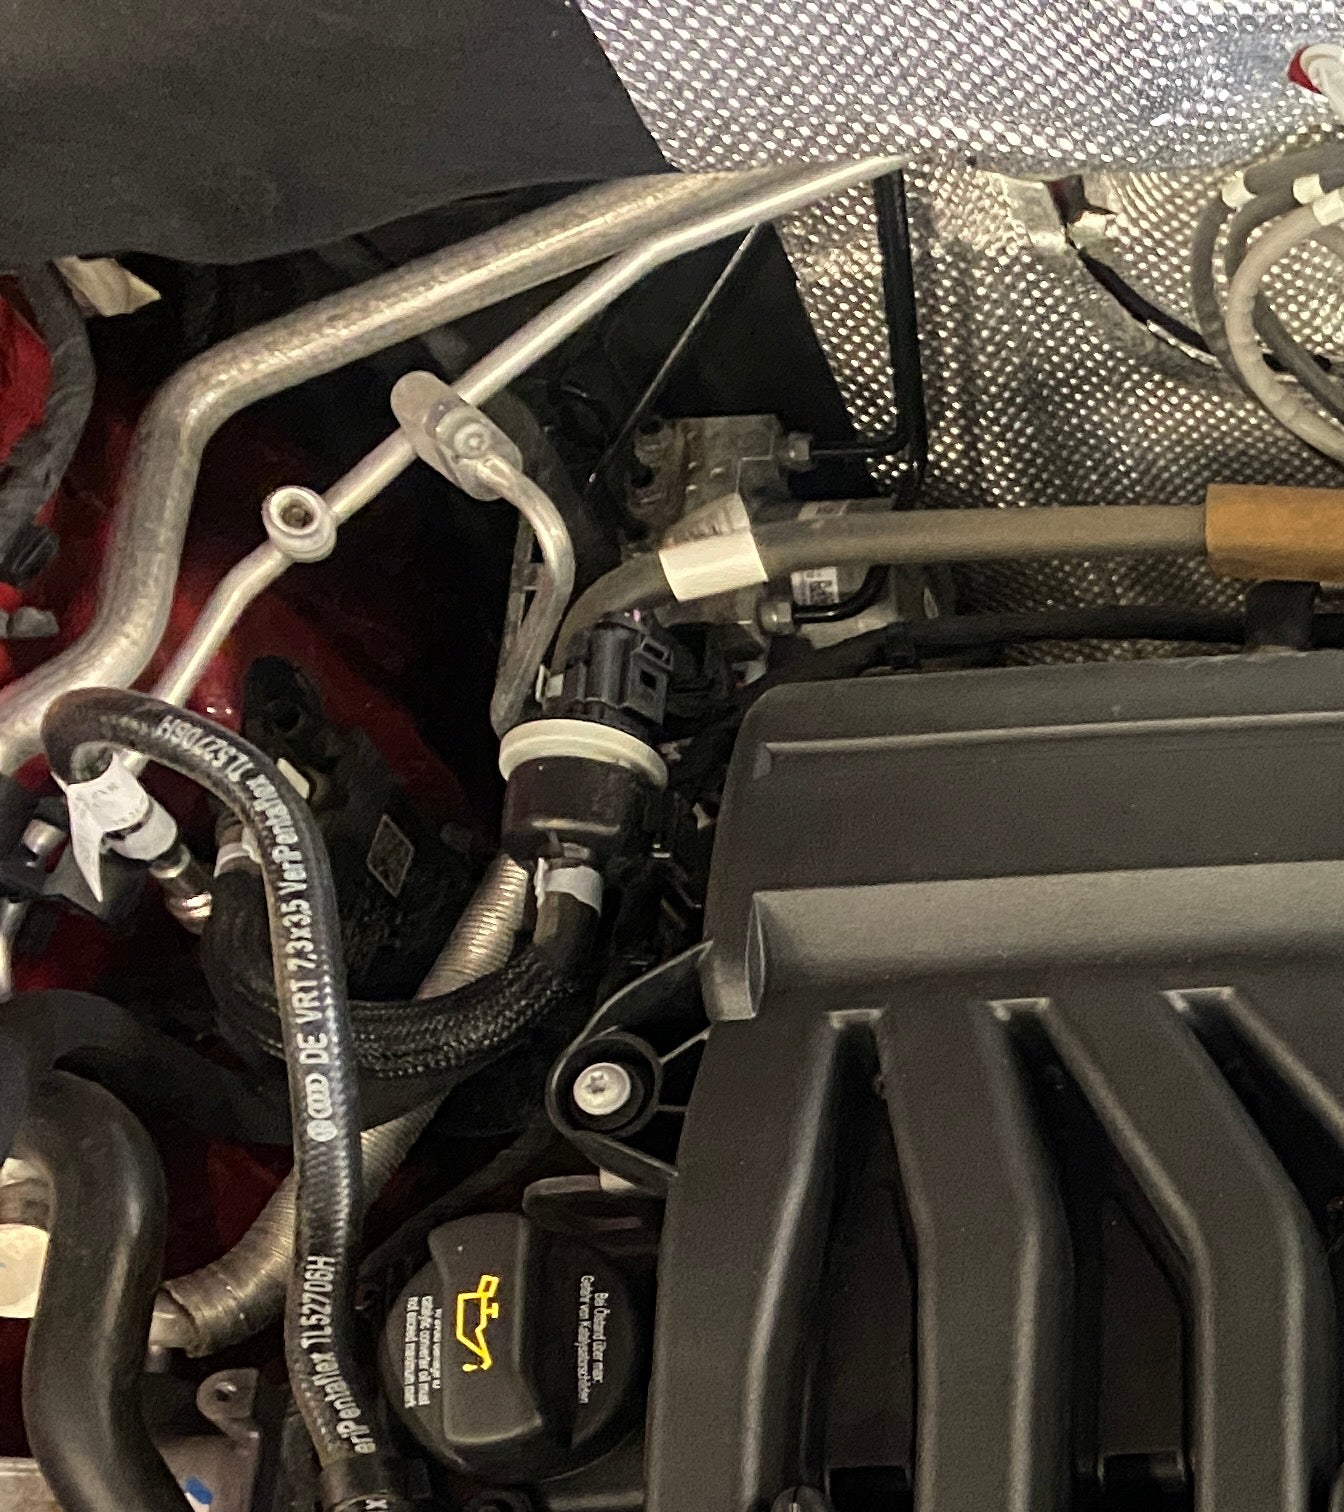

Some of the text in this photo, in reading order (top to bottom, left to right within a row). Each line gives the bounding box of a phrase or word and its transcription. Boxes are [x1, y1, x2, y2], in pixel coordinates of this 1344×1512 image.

[290, 977, 323, 1025] VRT
[297, 1032, 331, 1065] DE
[300, 1255, 377, 1454] eriPentaflex TL52706H
